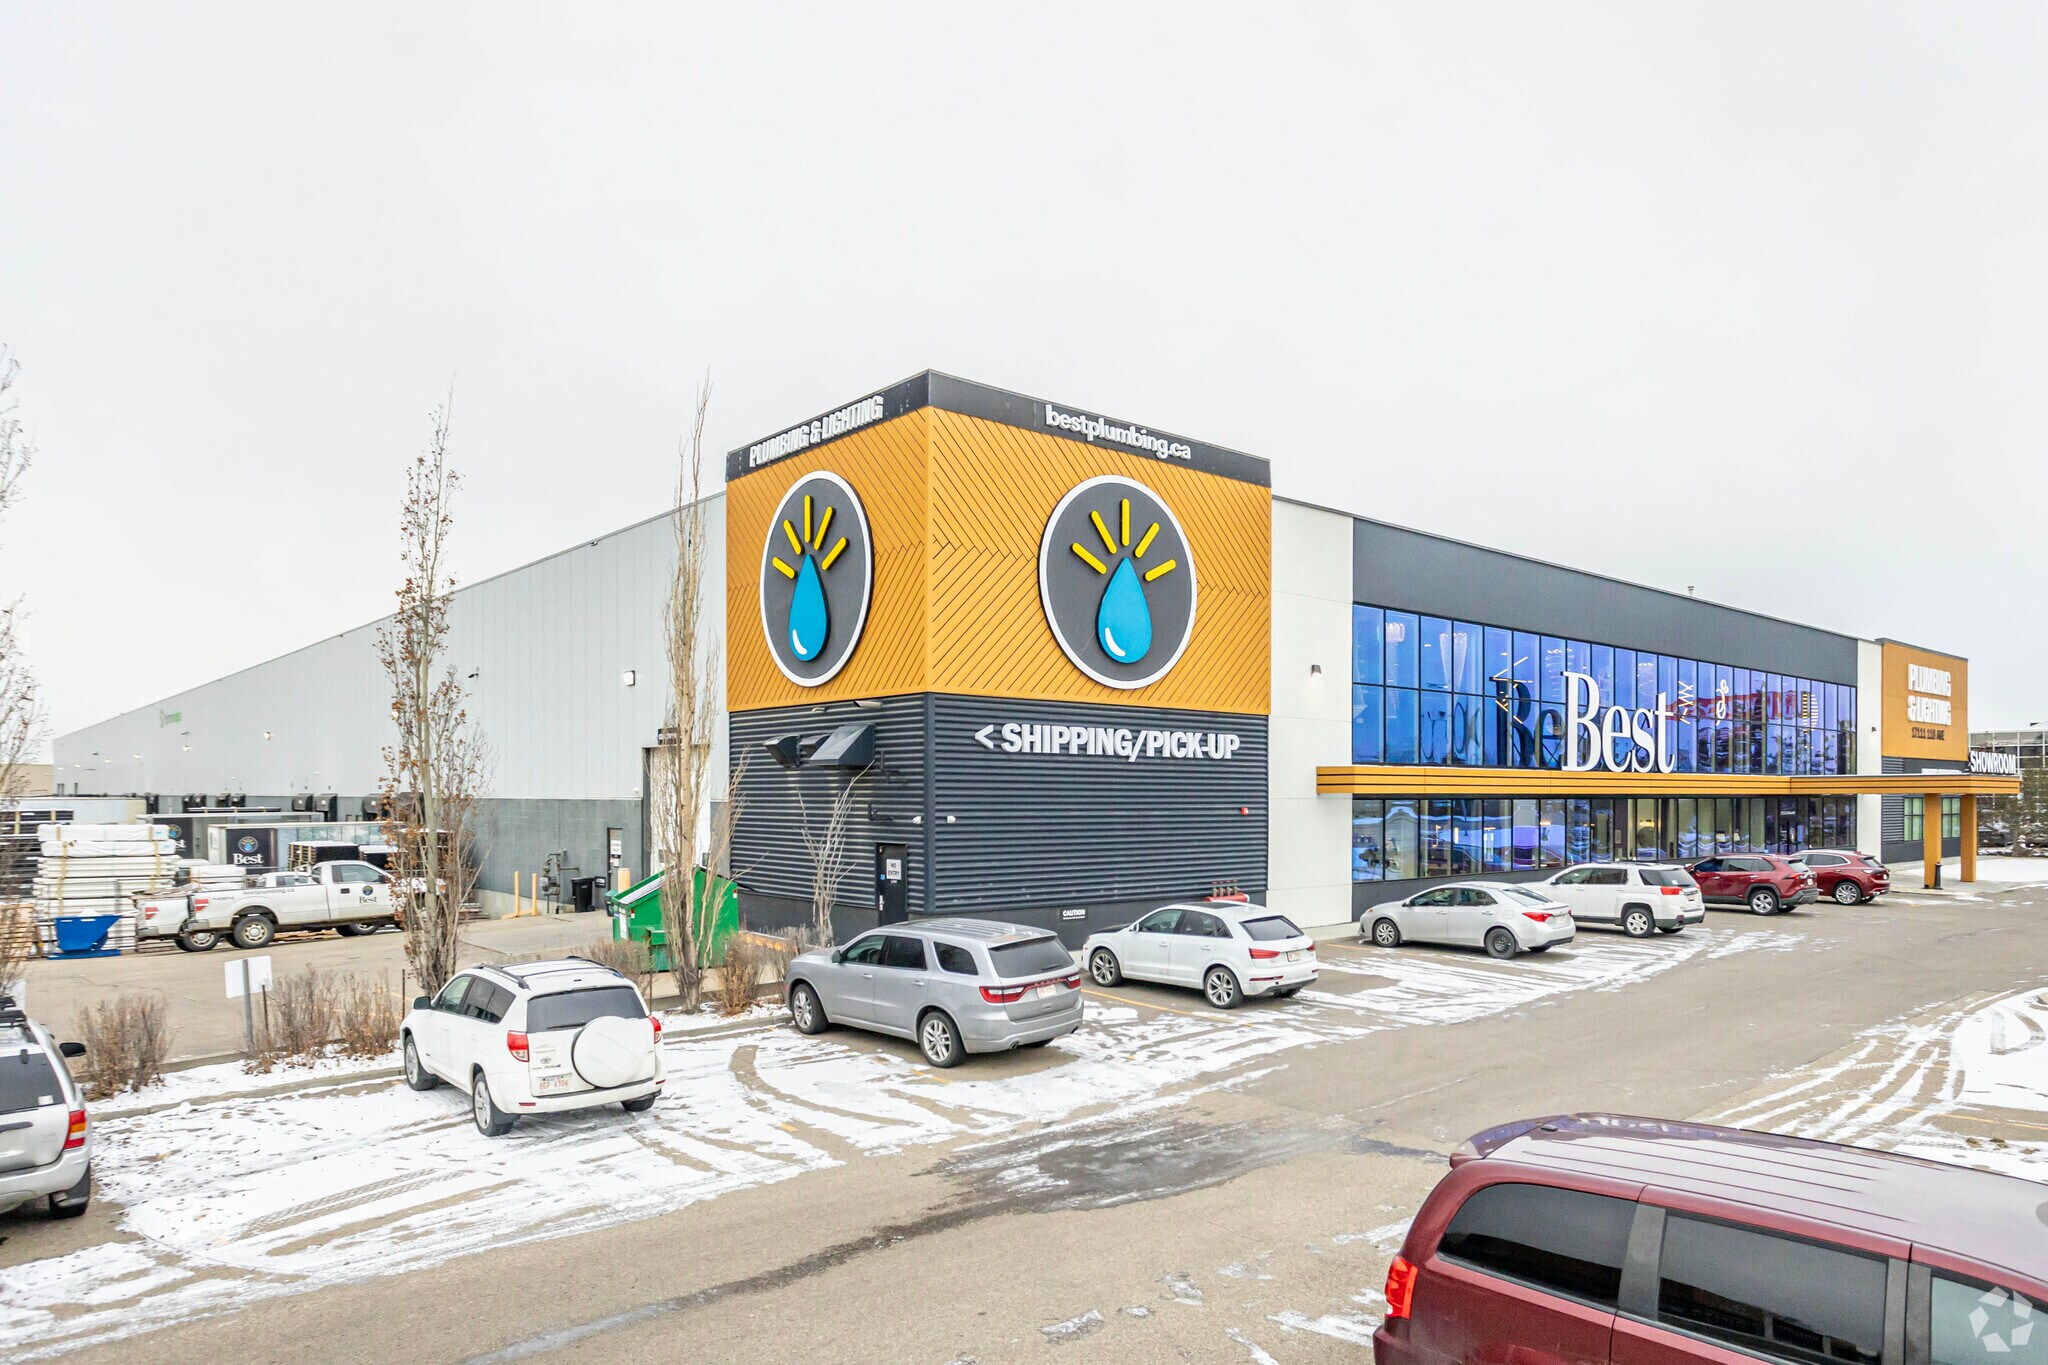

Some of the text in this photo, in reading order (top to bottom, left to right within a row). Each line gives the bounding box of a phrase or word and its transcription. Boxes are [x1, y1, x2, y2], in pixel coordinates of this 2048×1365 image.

[750, 395, 884, 467] PLUMBING & LIGHTING
[1045, 404, 1191, 460] bestplumbing.ca
[1907, 663, 1951, 697] PLUMBING
[1561, 671, 1675, 774] Best
[1001, 723, 1240, 762] SHIPPING/PICK-UP
[1970, 750, 2016, 775] SHOWROOM
[233, 853, 264, 865] Best
[359, 896, 377, 904] Best
[1062, 909, 1086, 917] CAUTION
